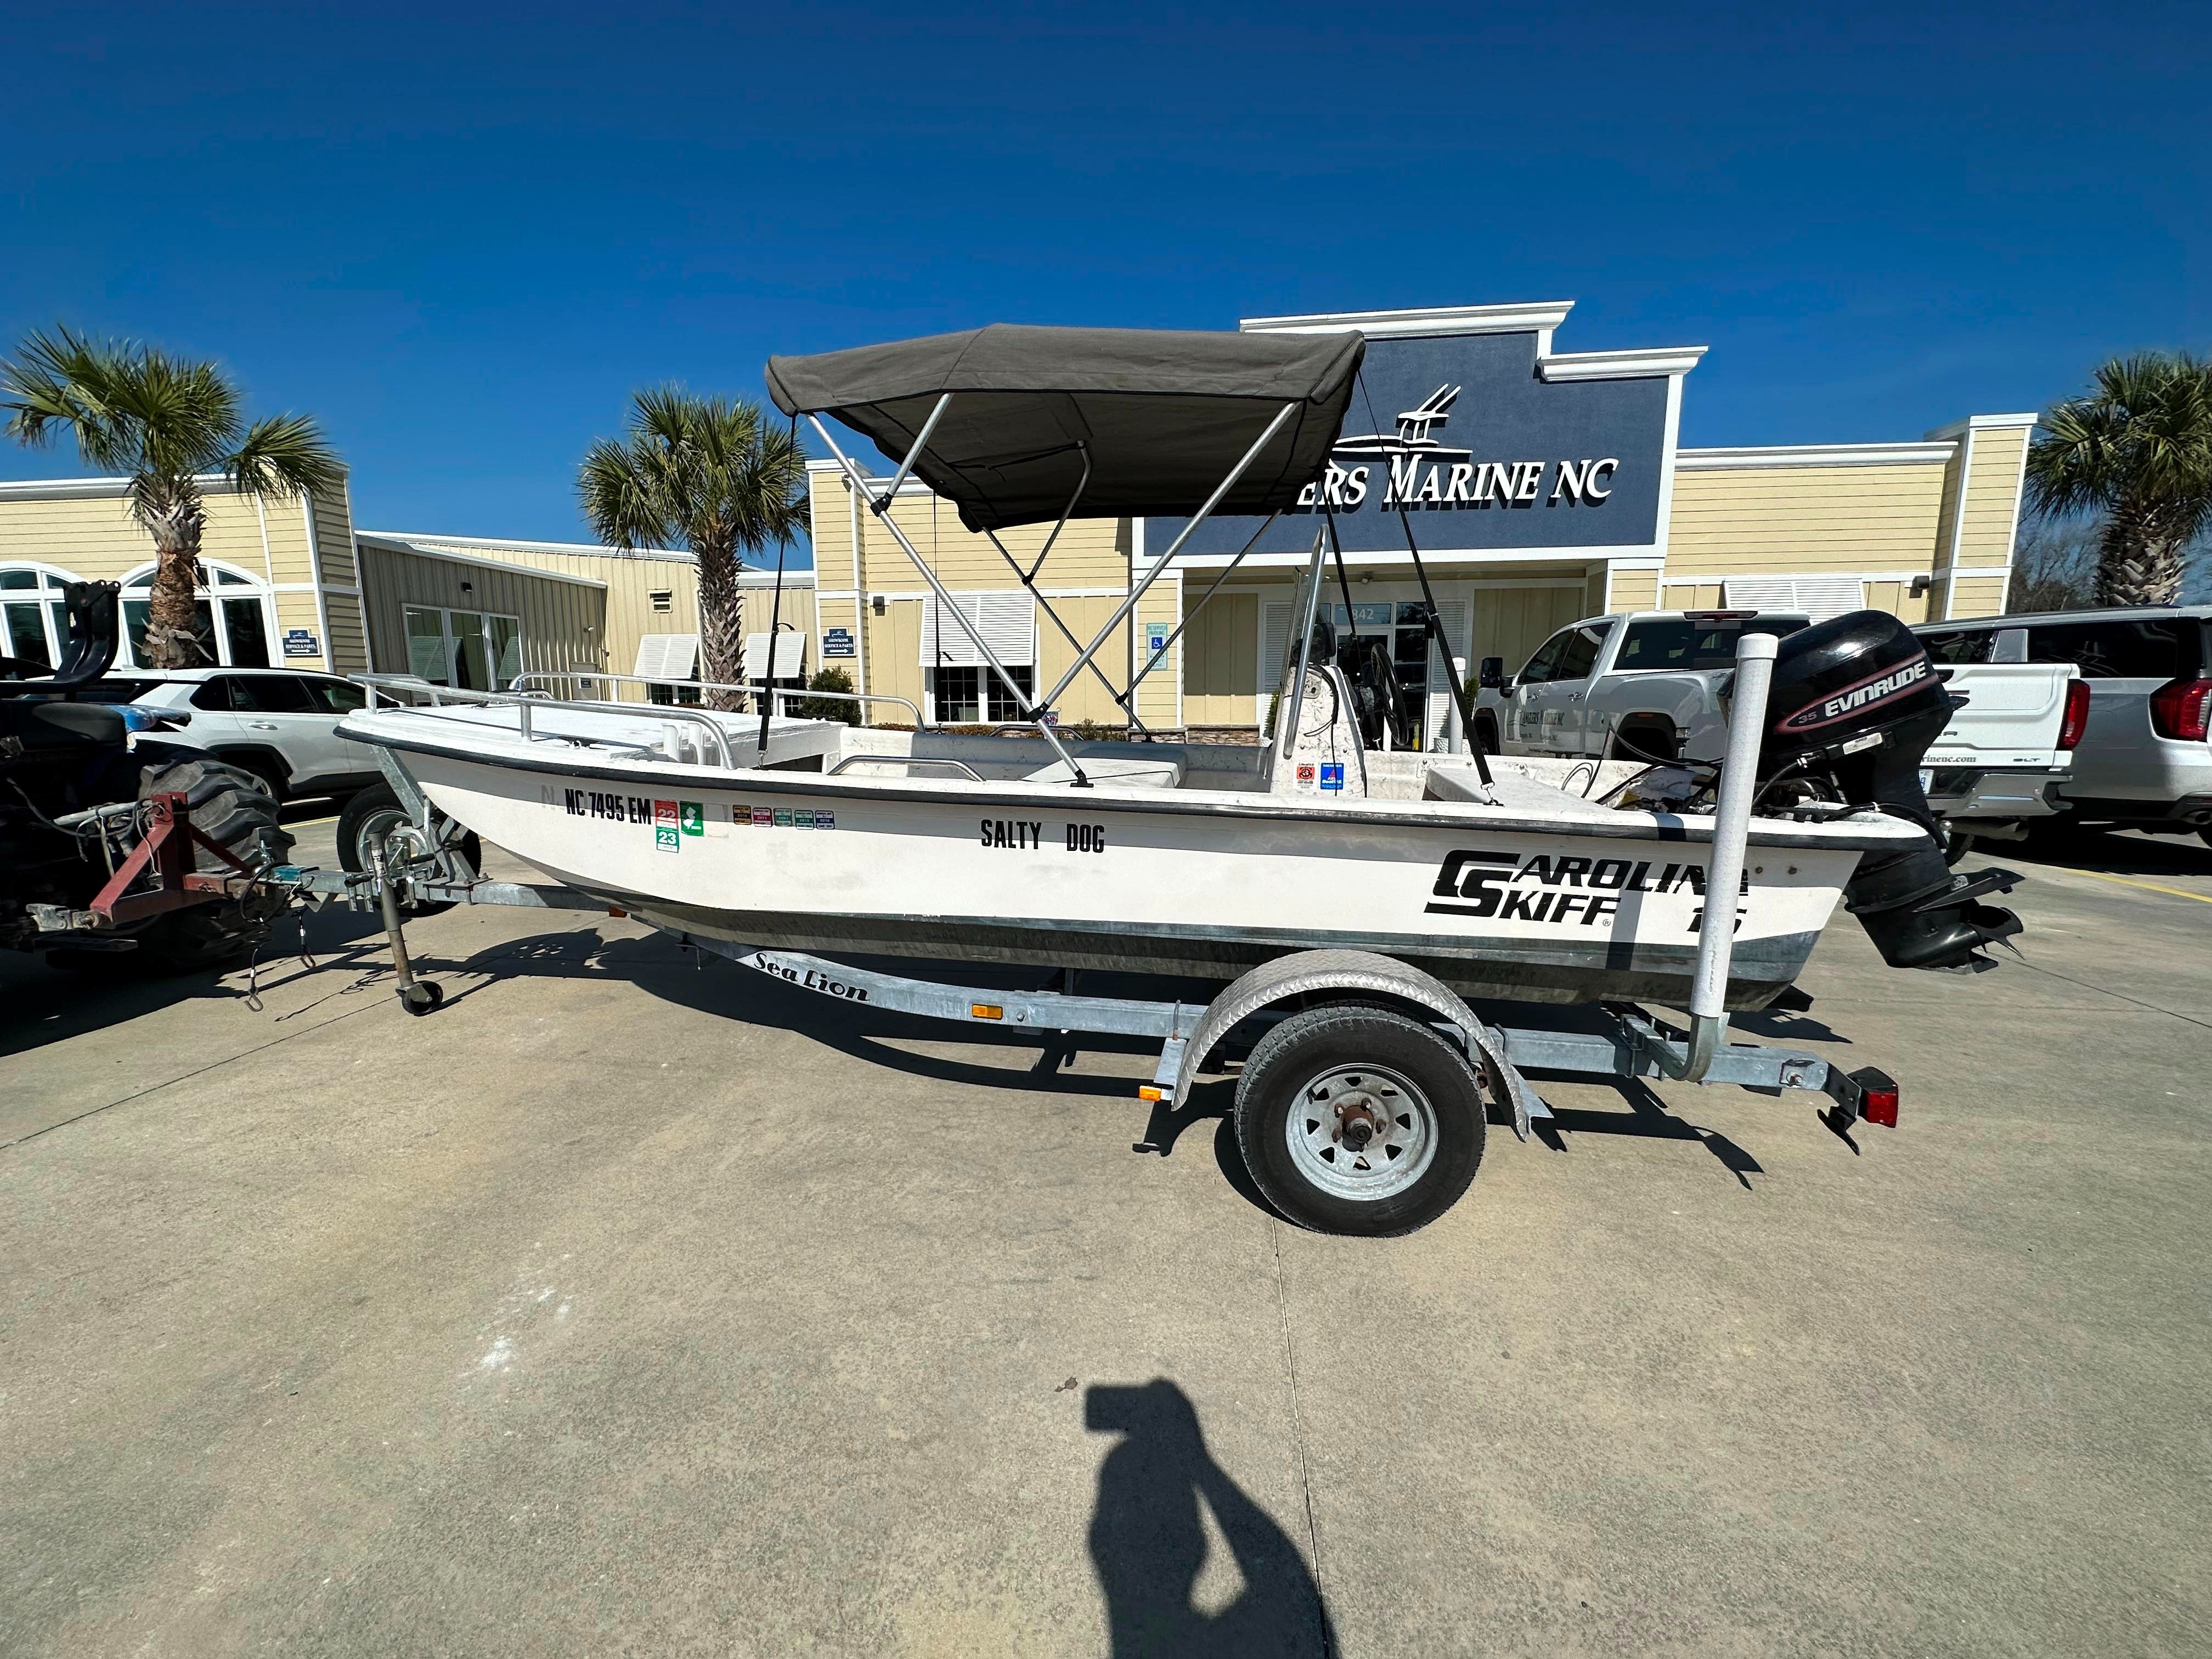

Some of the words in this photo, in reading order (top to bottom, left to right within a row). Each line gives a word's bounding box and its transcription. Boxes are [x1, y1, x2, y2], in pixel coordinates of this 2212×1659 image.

[1383, 453, 1545, 503] MARINE
[1550, 458, 1620, 499] NC
[1825, 661, 1926, 717] EVINRUDE
[1798, 711, 1818, 724] 35
[565, 788, 585, 816] NC
[588, 792, 624, 822] 7495
[628, 797, 652, 825] EM
[658, 808, 676, 822] 22
[658, 831, 676, 845] 23
[981, 819, 1042, 850] SALTY
[1066, 823, 1105, 854] DOG
[1432, 849, 1749, 897] CAROLIN
[1423, 869, 1622, 926] SKIFF
[754, 952, 798, 982] Sea
[803, 969, 871, 1001] Lion
